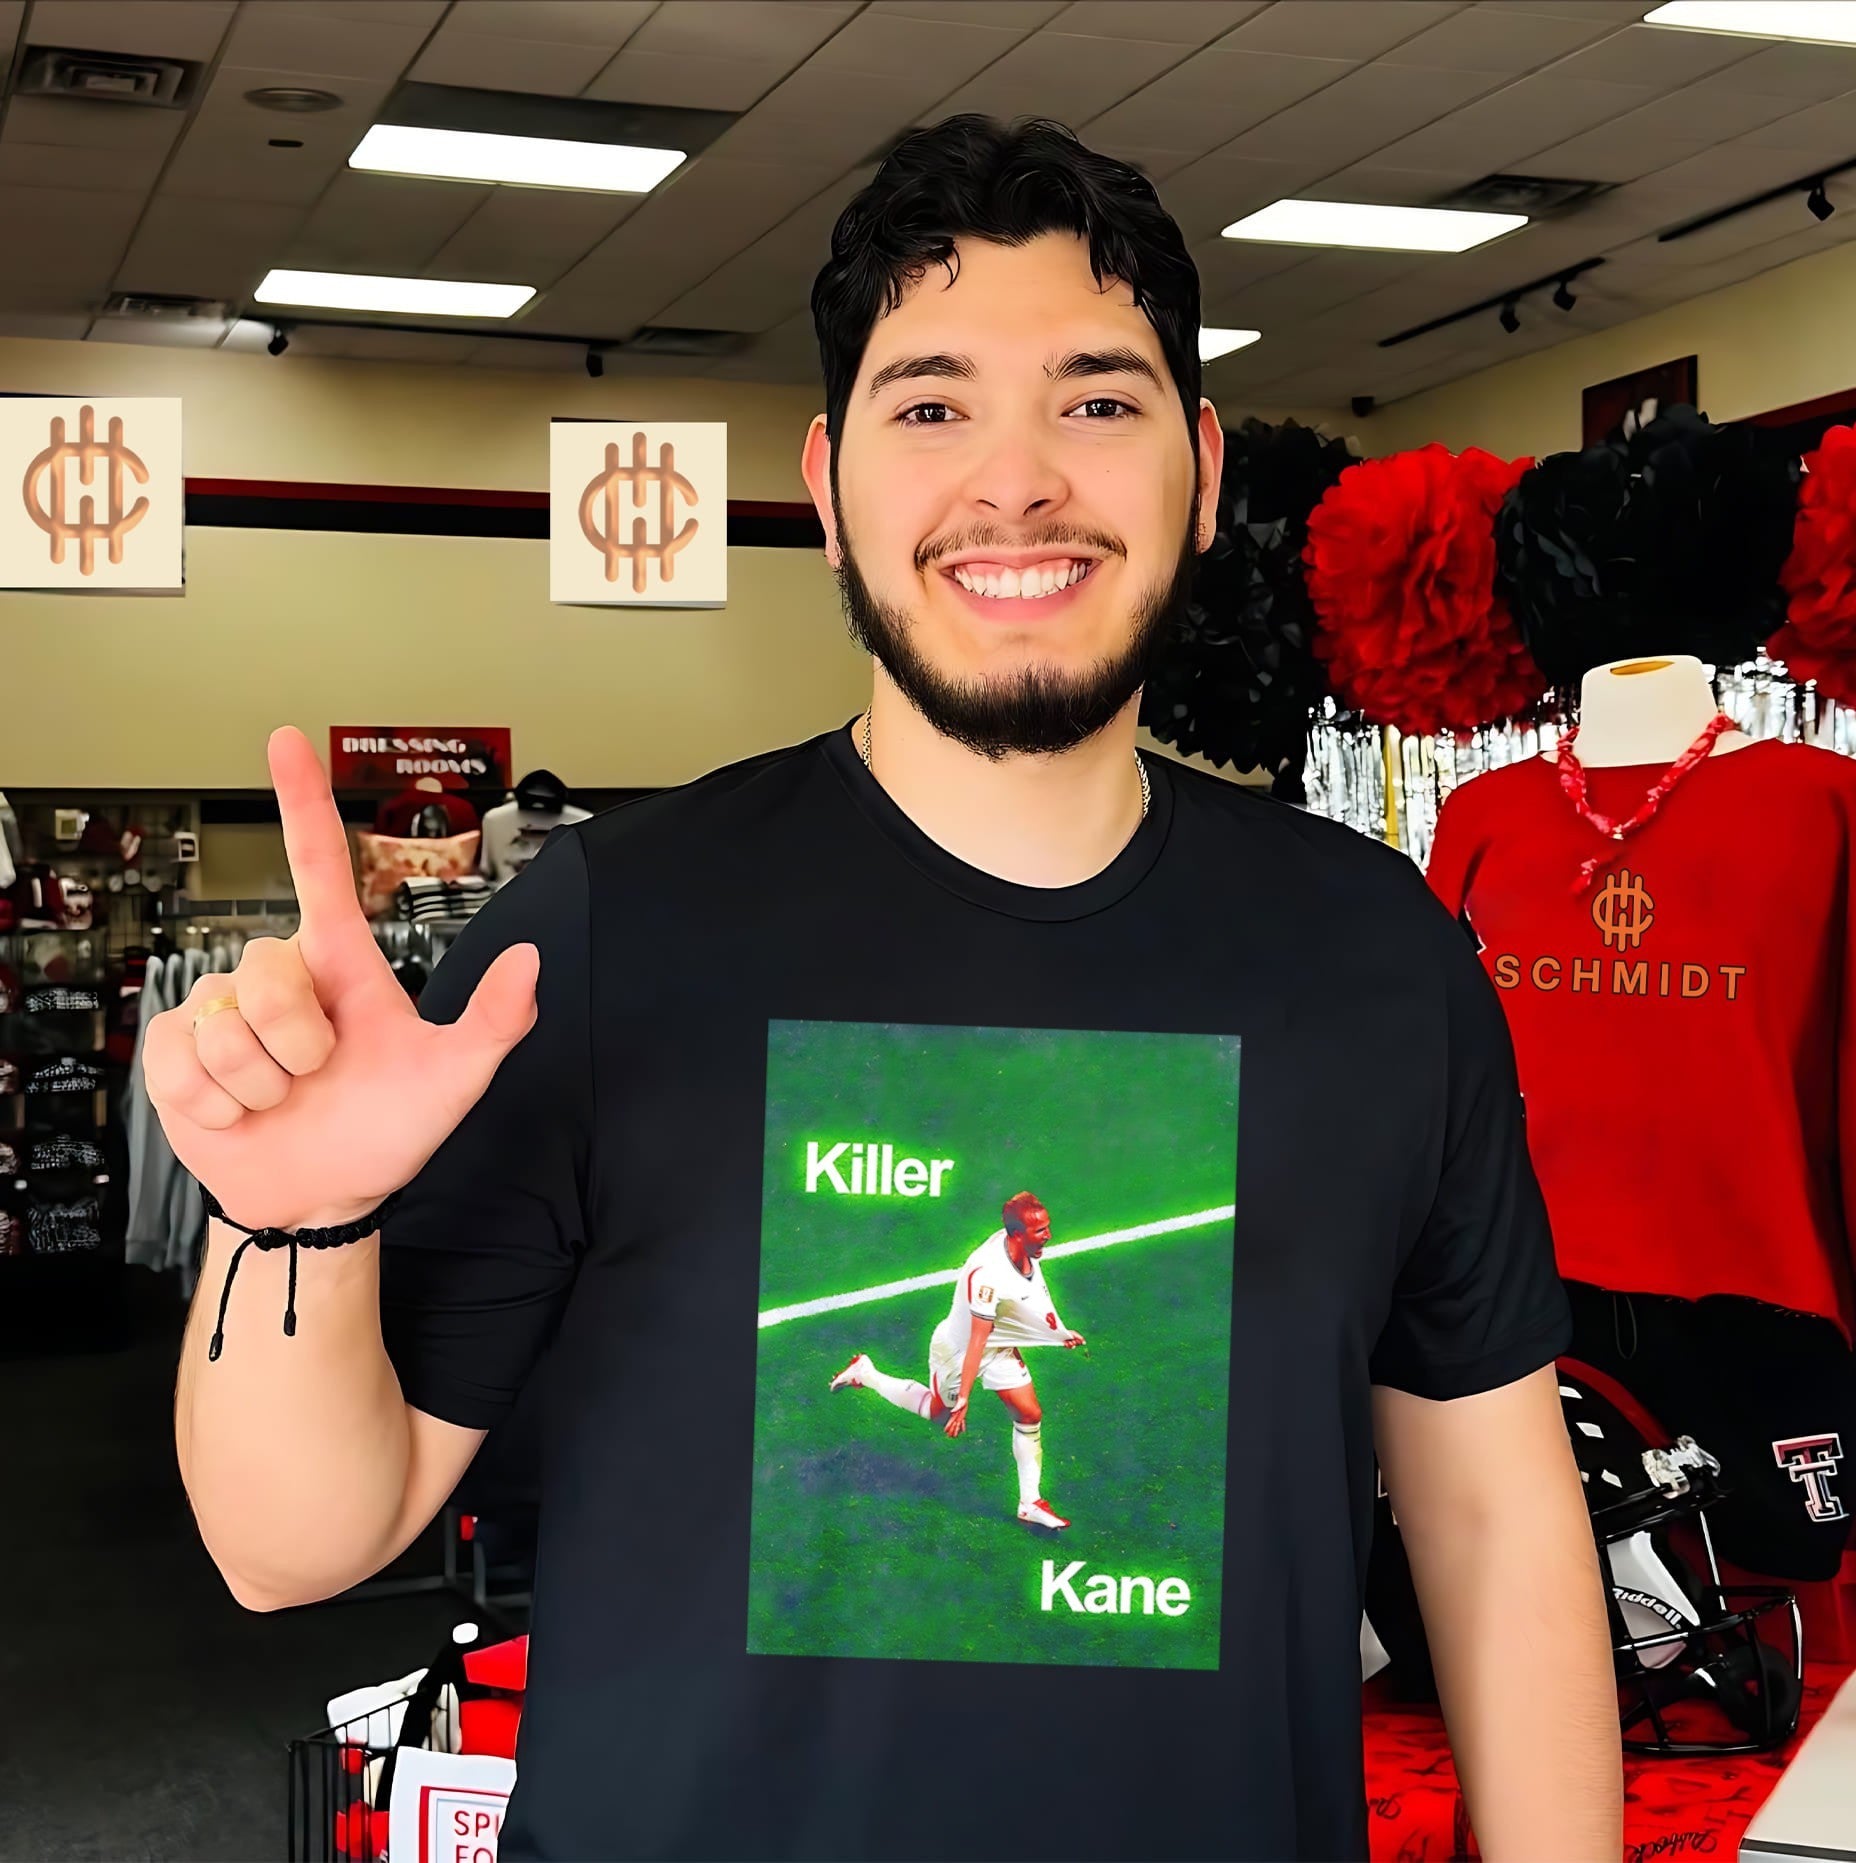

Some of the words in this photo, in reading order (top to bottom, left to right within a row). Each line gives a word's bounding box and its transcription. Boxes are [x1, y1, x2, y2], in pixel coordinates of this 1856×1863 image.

[396, 758, 487, 775] ROOMS
[1494, 953, 1747, 1001] SCHMIDT
[805, 1141, 955, 1198] Killer
[1040, 1558, 1191, 1617] Kane
